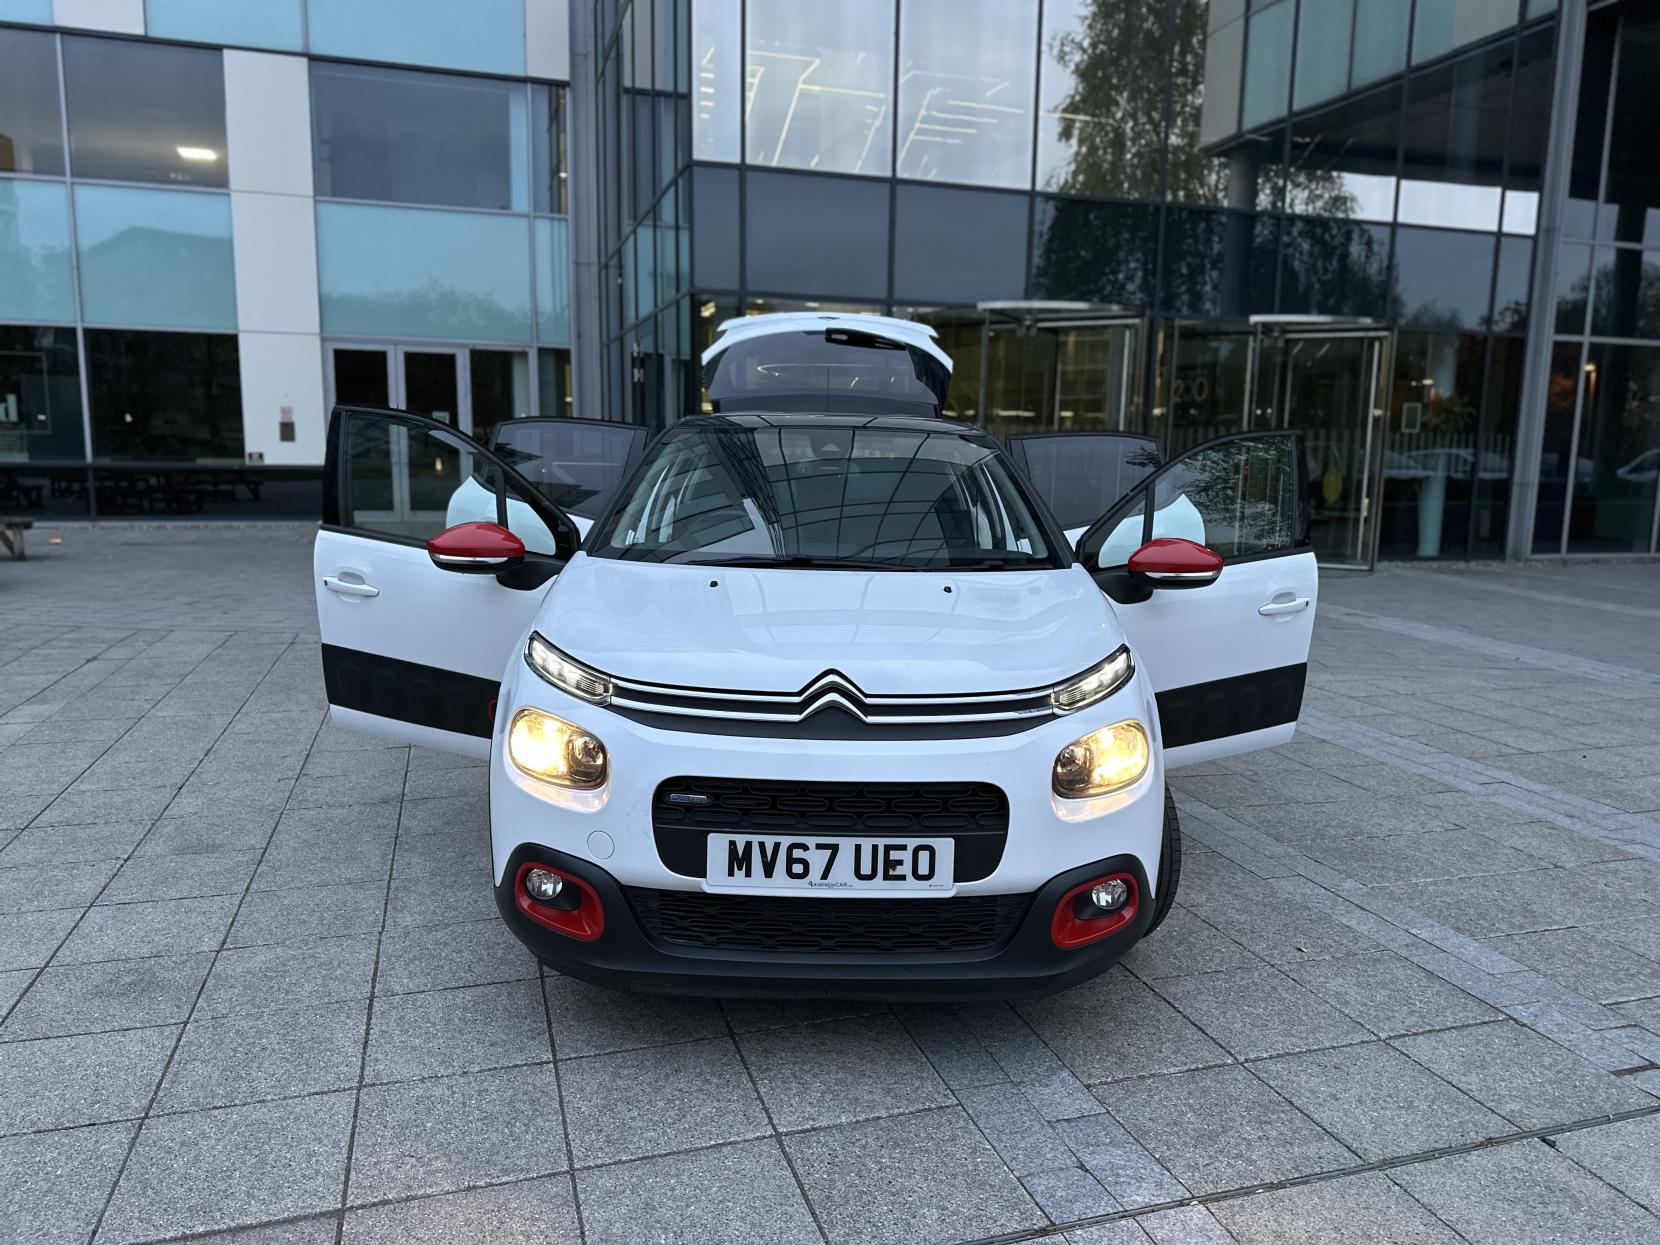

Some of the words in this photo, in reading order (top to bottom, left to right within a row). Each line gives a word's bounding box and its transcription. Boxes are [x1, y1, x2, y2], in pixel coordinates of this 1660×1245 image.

[1173, 378, 1208, 402] 200
[727, 839, 840, 880] MV67
[853, 843, 936, 881] UEO
